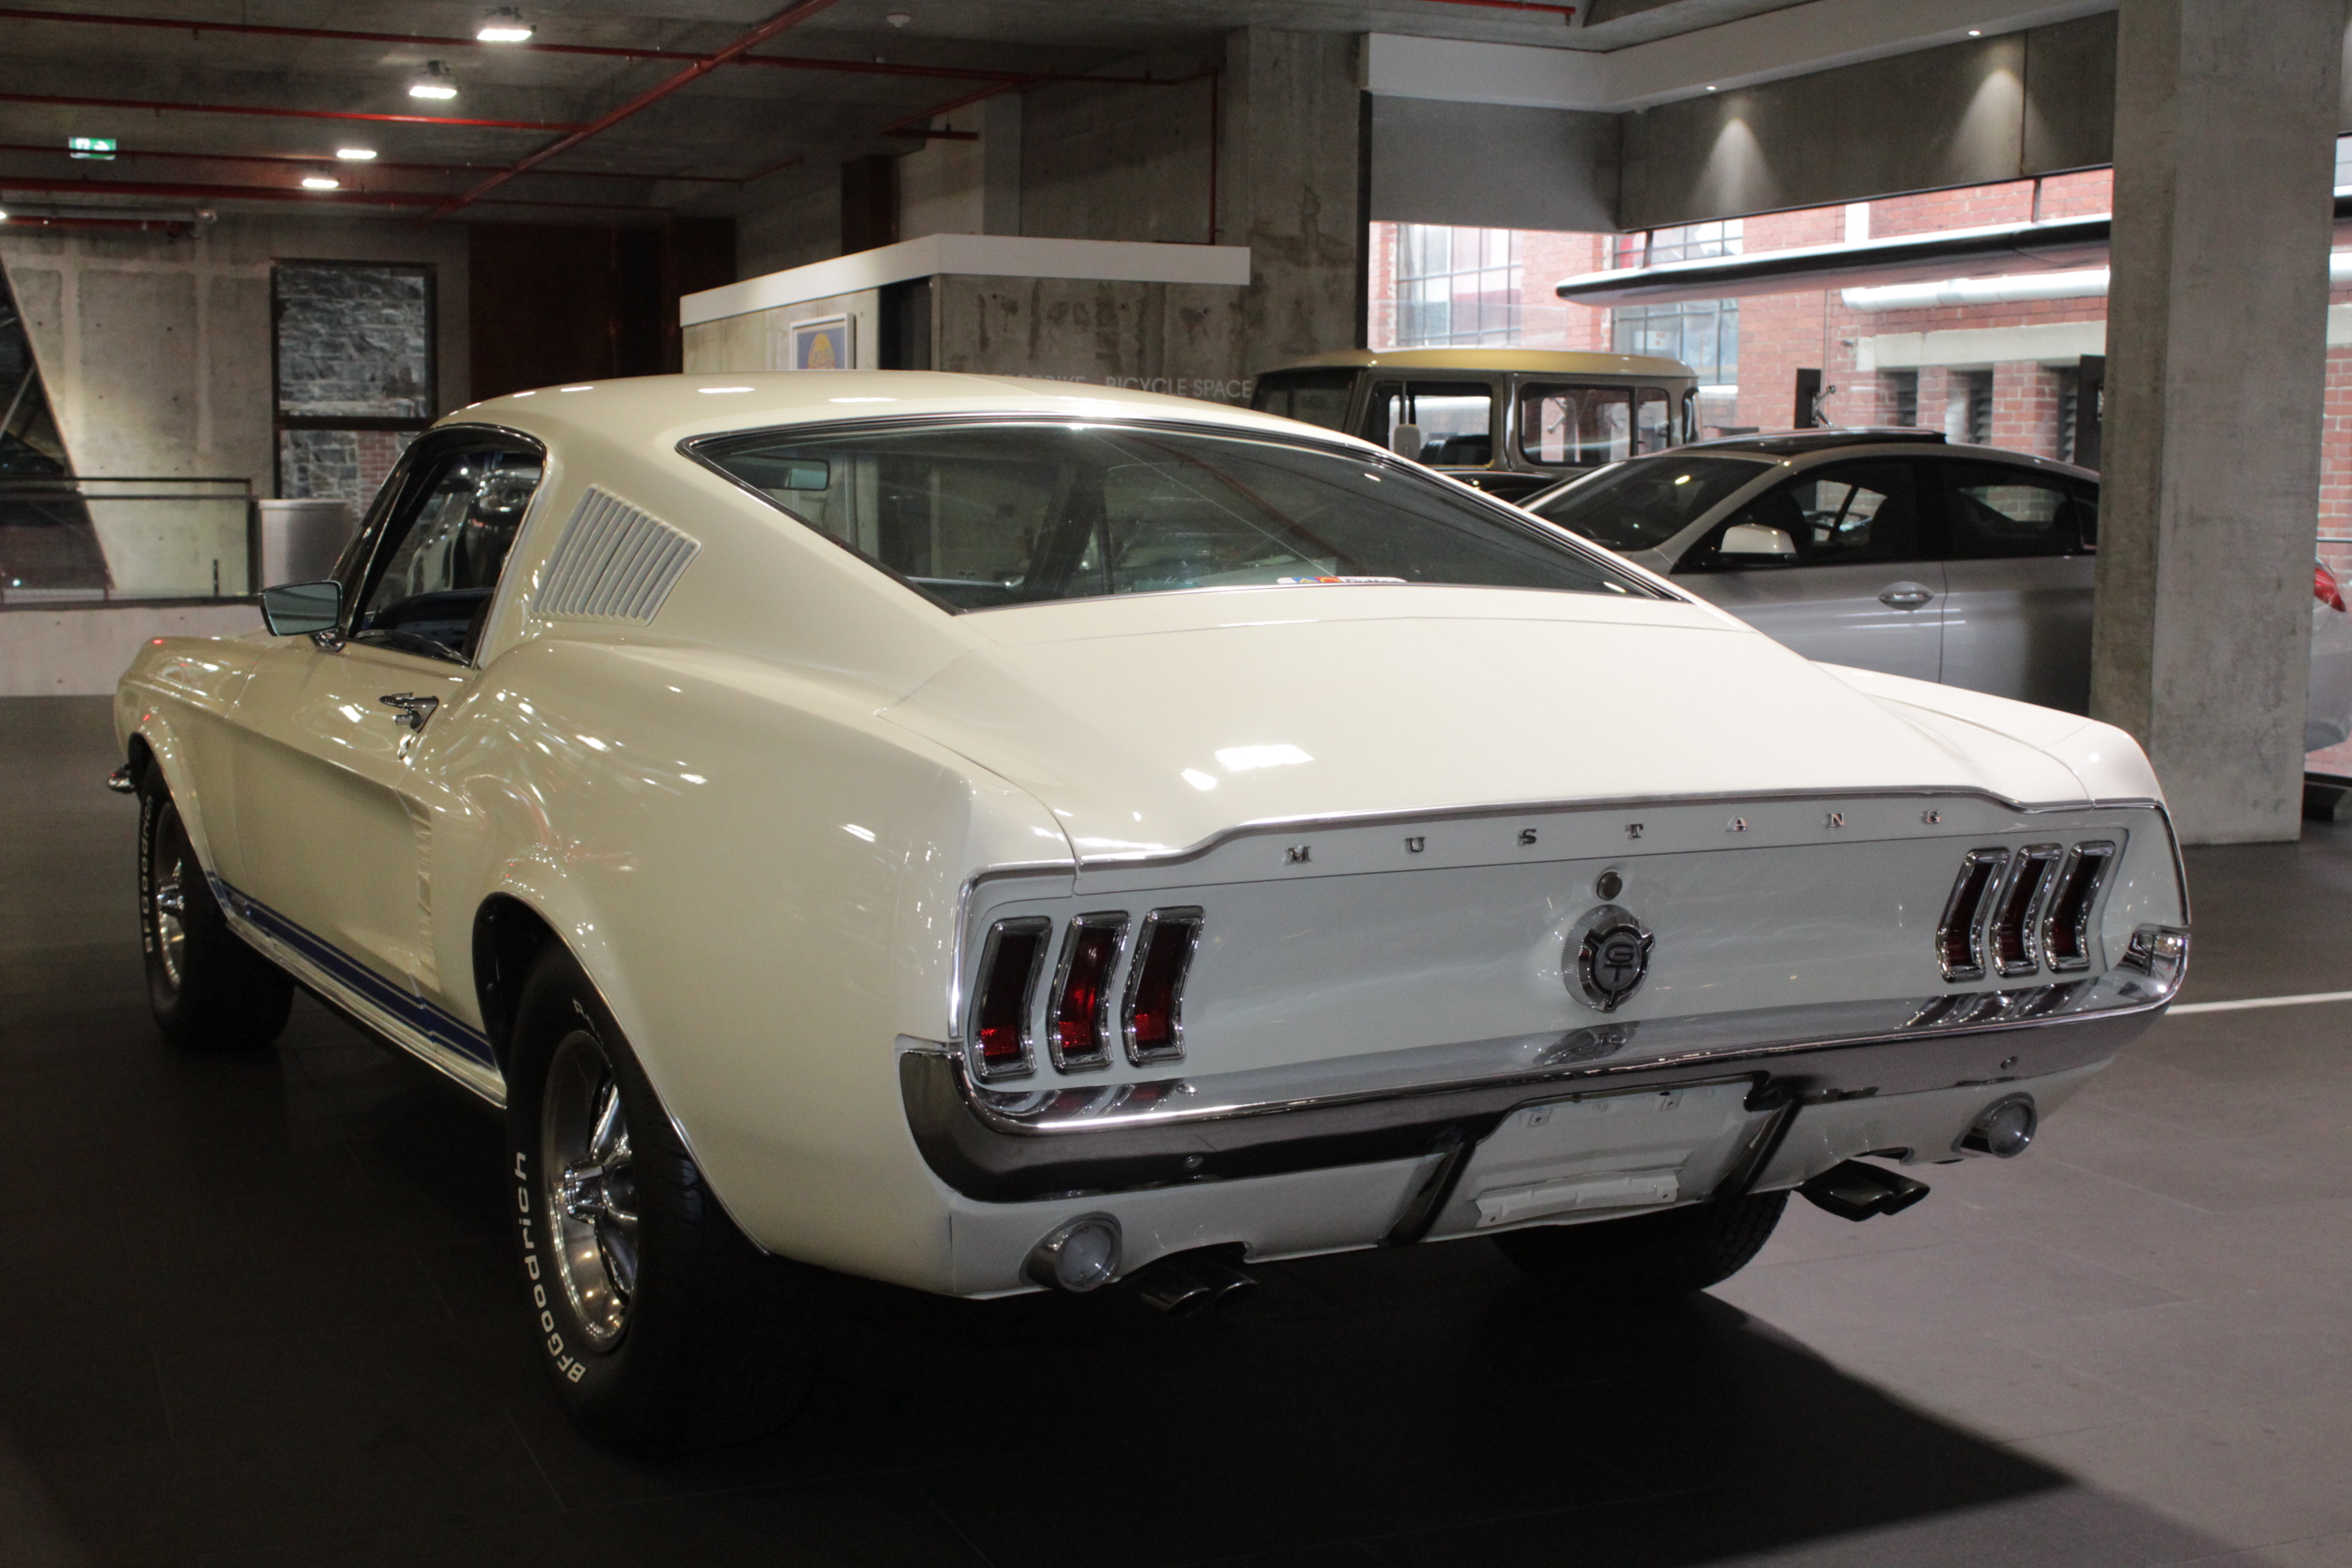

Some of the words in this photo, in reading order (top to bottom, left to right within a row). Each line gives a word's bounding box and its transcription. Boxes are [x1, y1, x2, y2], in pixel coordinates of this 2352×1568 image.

[1192, 378, 1252, 398] SPACE
[1284, 808, 1941, 864] MUSTANG
[515, 1152, 586, 1384] BFGoodrich
